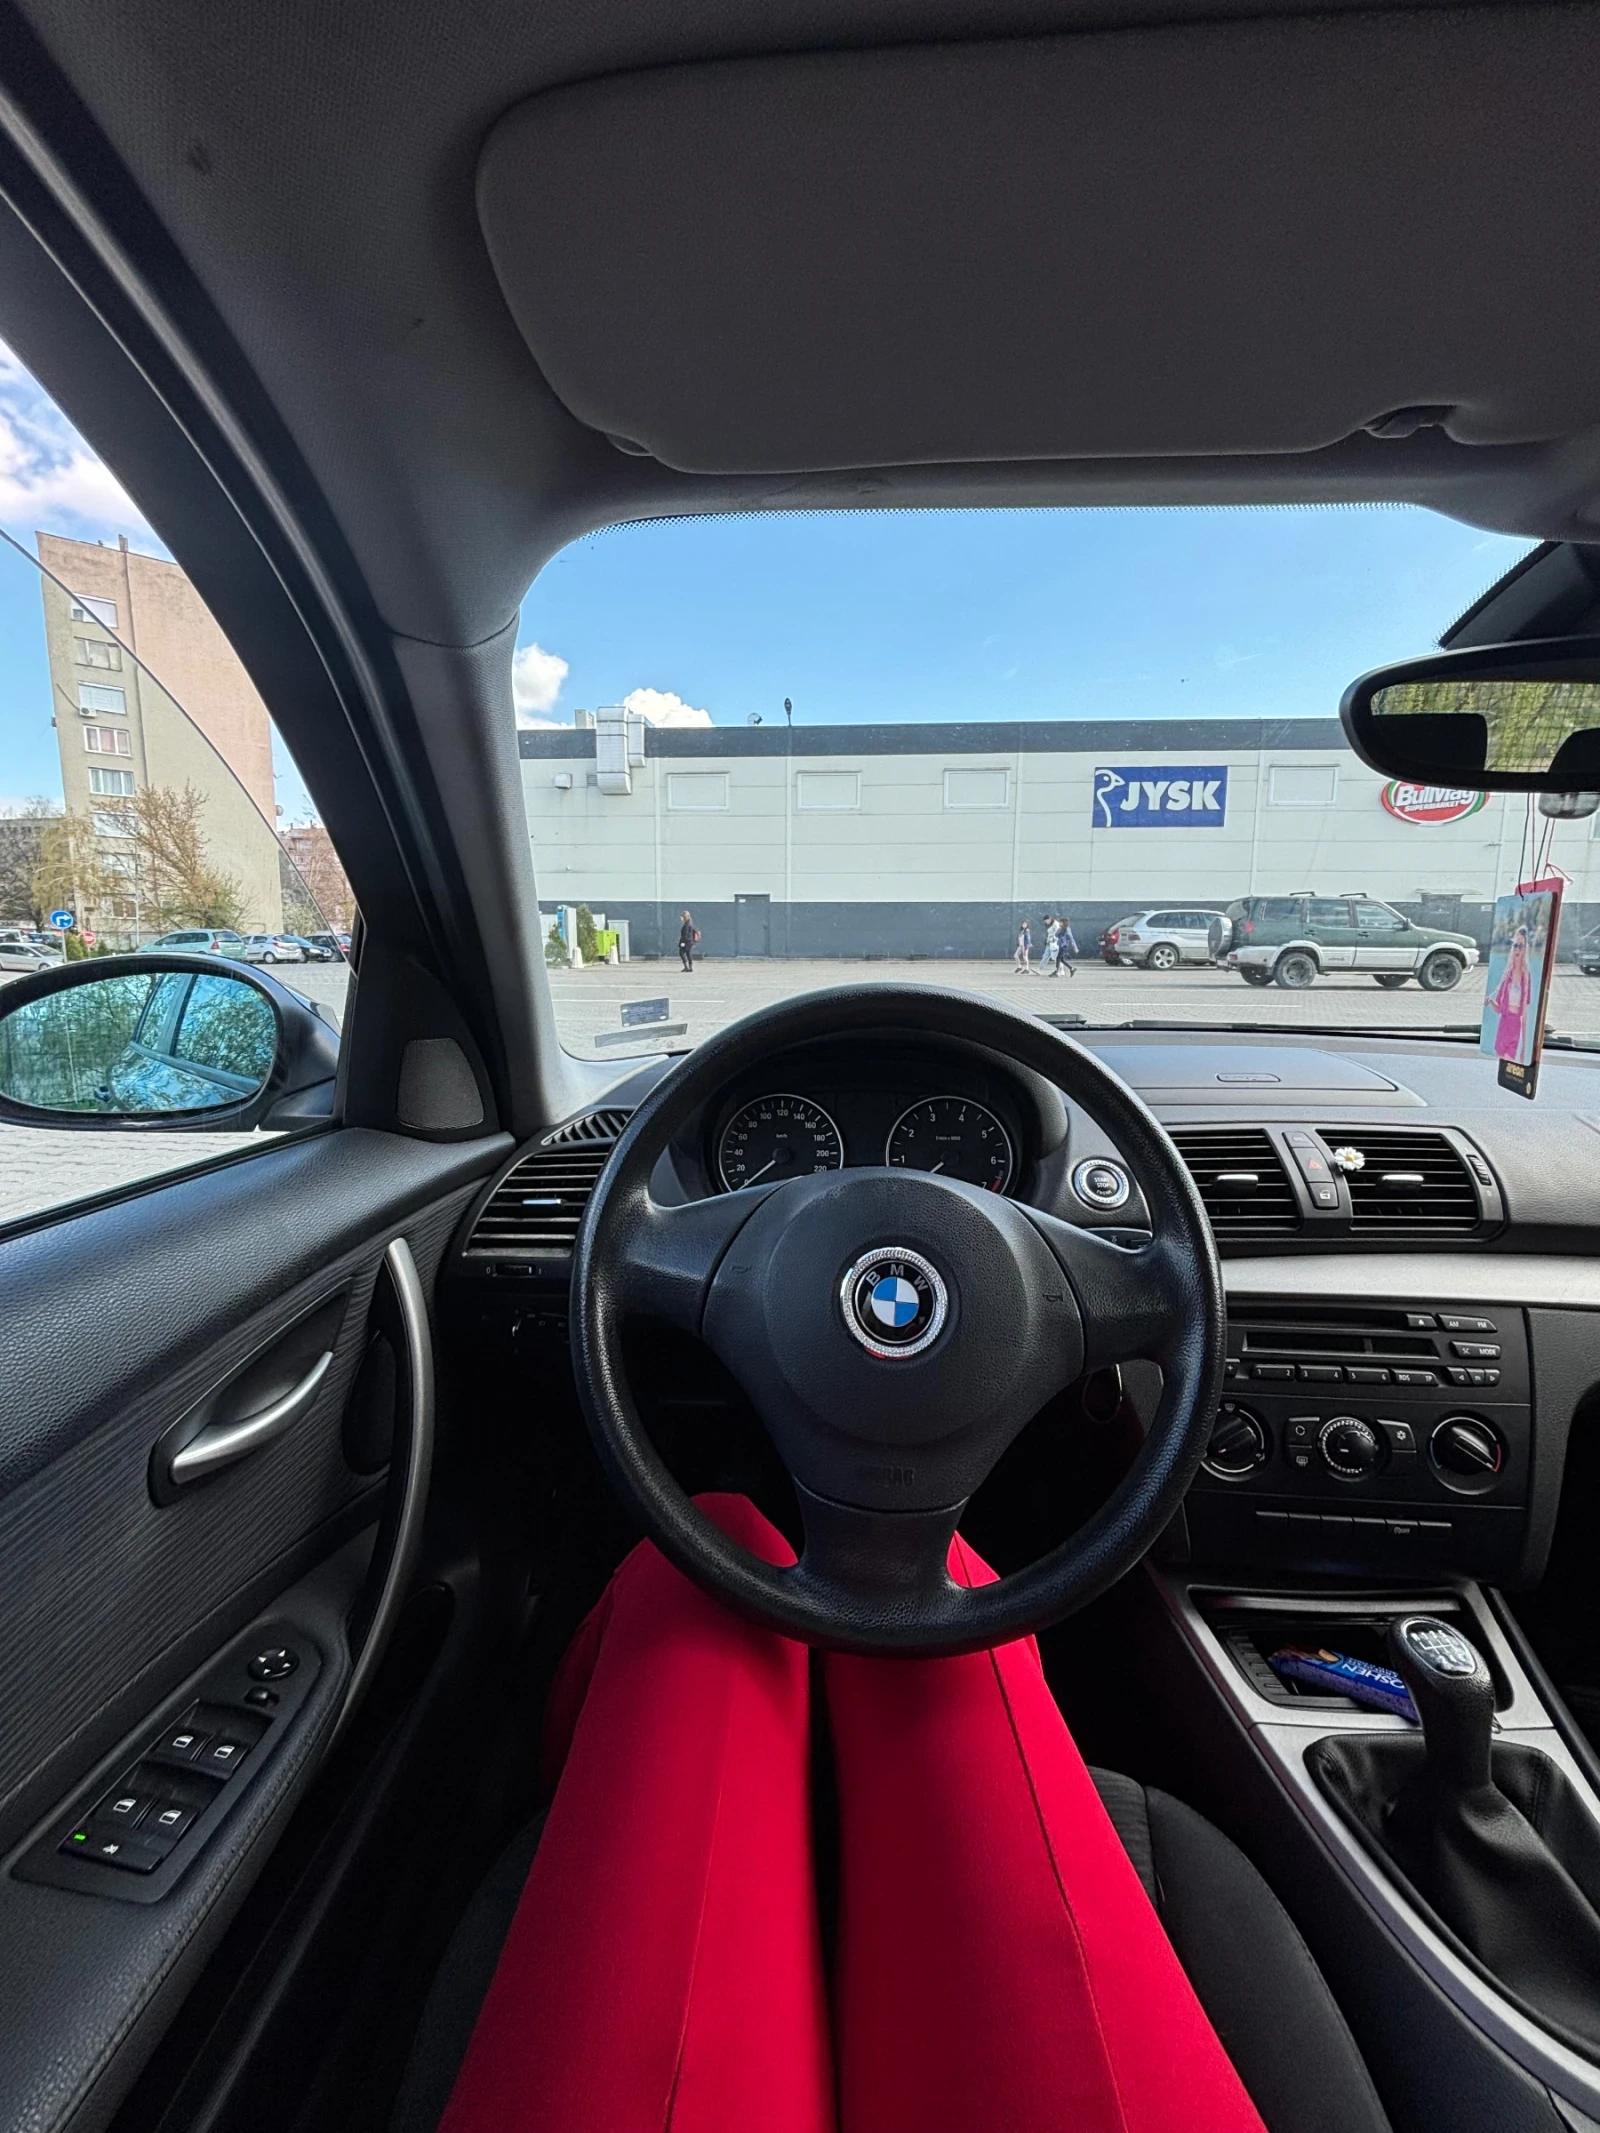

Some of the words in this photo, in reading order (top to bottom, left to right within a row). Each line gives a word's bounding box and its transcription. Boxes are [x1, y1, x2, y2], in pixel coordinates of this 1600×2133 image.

[1120, 780, 1222, 811] JYSK
[1404, 801, 1460, 812] SUPERMARKET
[760, 1112, 772, 1120] 100
[930, 1113, 936, 1122] 3
[959, 1113, 965, 1122] 4
[805, 1121, 817, 1129] 160
[908, 1129, 915, 1138] 2
[981, 1130, 988, 1139] 5
[816, 1149, 829, 1157] 200
[990, 1155, 997, 1165] 6
[736, 1164, 746, 1172] 20
[866, 1263, 929, 1292] BMW
[1477, 1321, 1487, 1329] FM
[1462, 1347, 1471, 1355] SC
[1479, 1348, 1497, 1356] MODE
[1399, 1374, 1411, 1382] RDS
[1342, 1663, 1406, 1689] OSHEN
